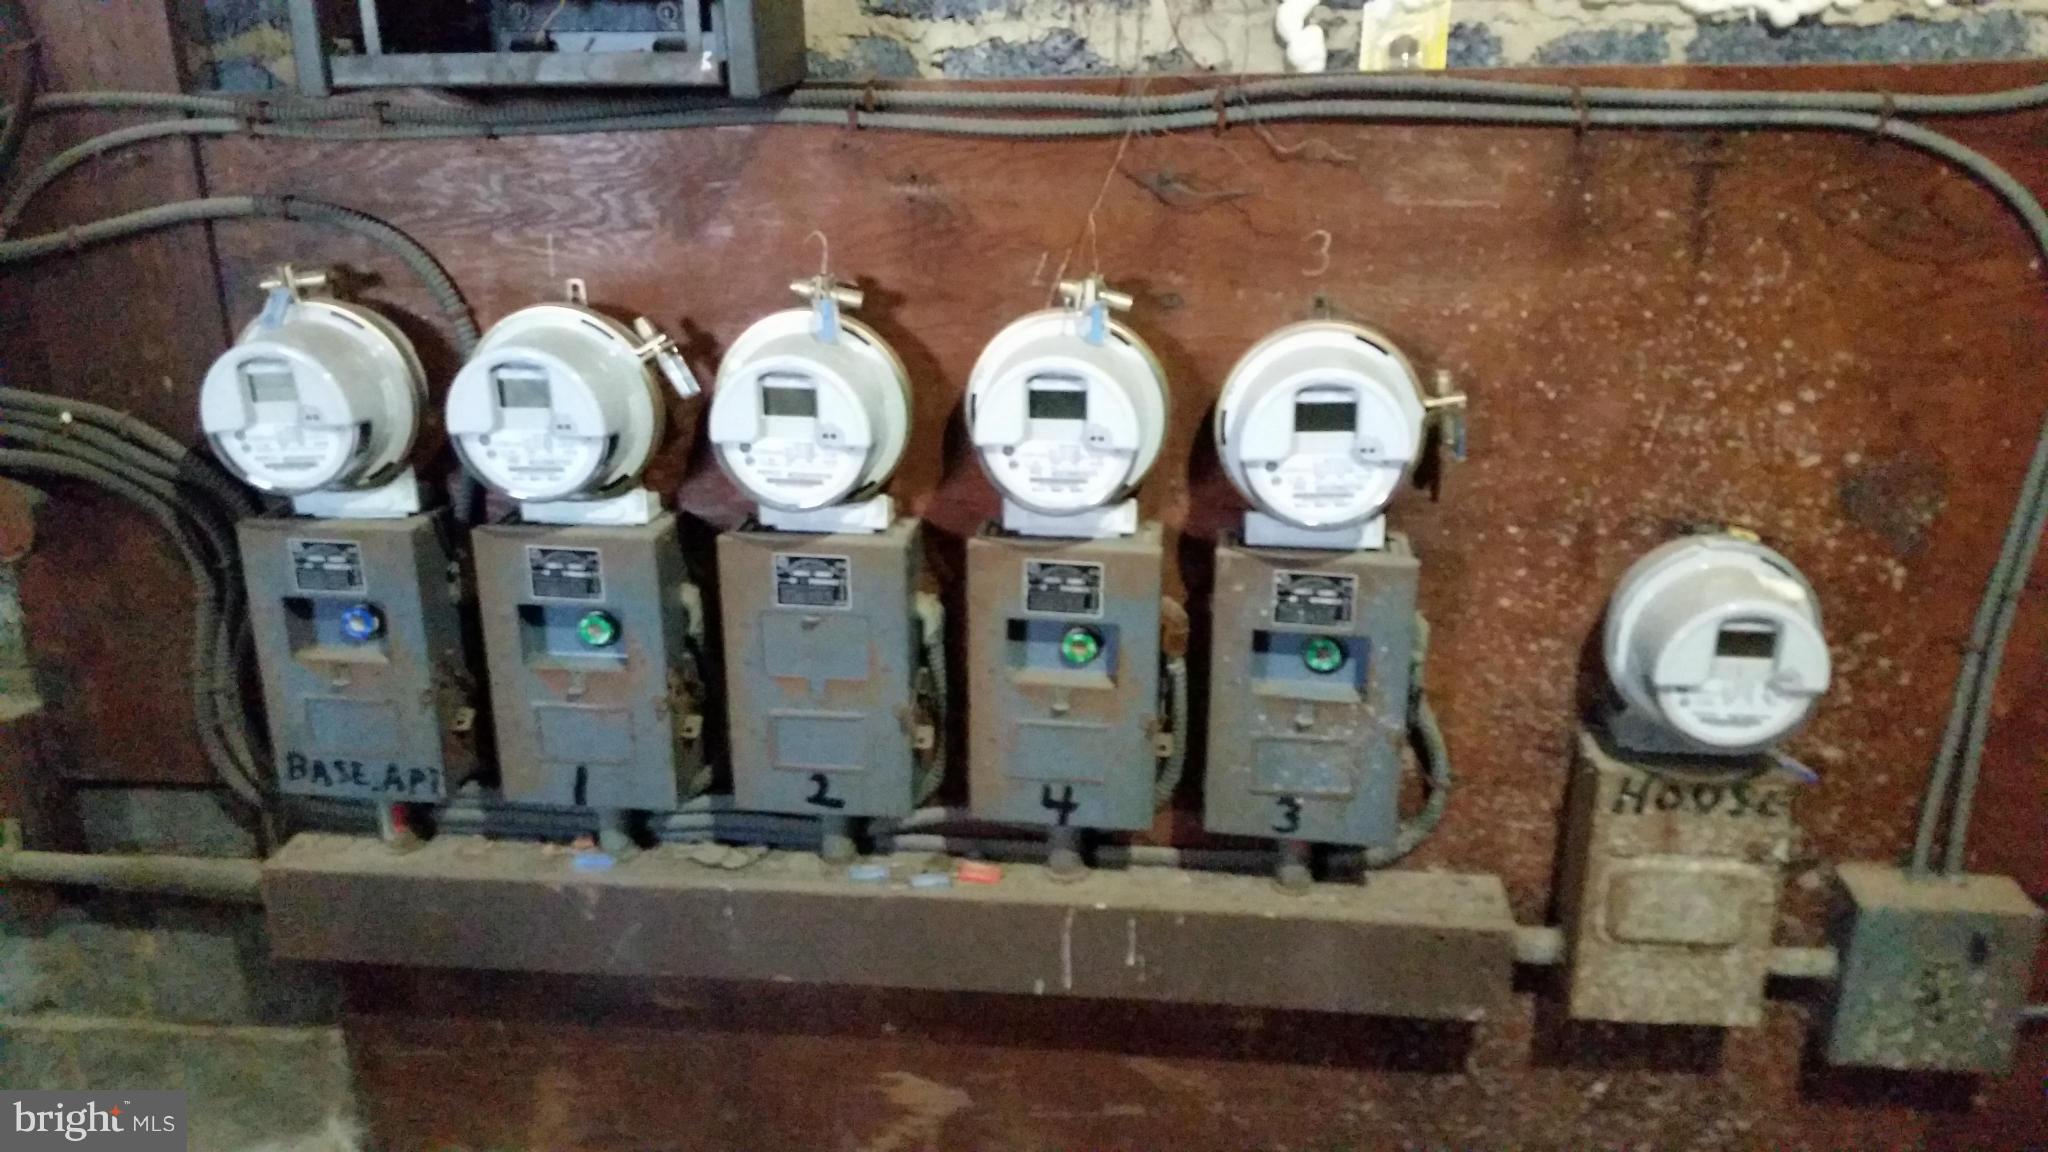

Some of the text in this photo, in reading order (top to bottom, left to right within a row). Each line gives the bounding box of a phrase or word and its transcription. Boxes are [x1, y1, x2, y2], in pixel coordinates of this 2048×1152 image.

[1301, 228, 1332, 277] 3
[574, 765, 588, 806] 1
[806, 773, 846, 809] 2
[1042, 784, 1079, 825] 4
[1272, 795, 1302, 833] 3
